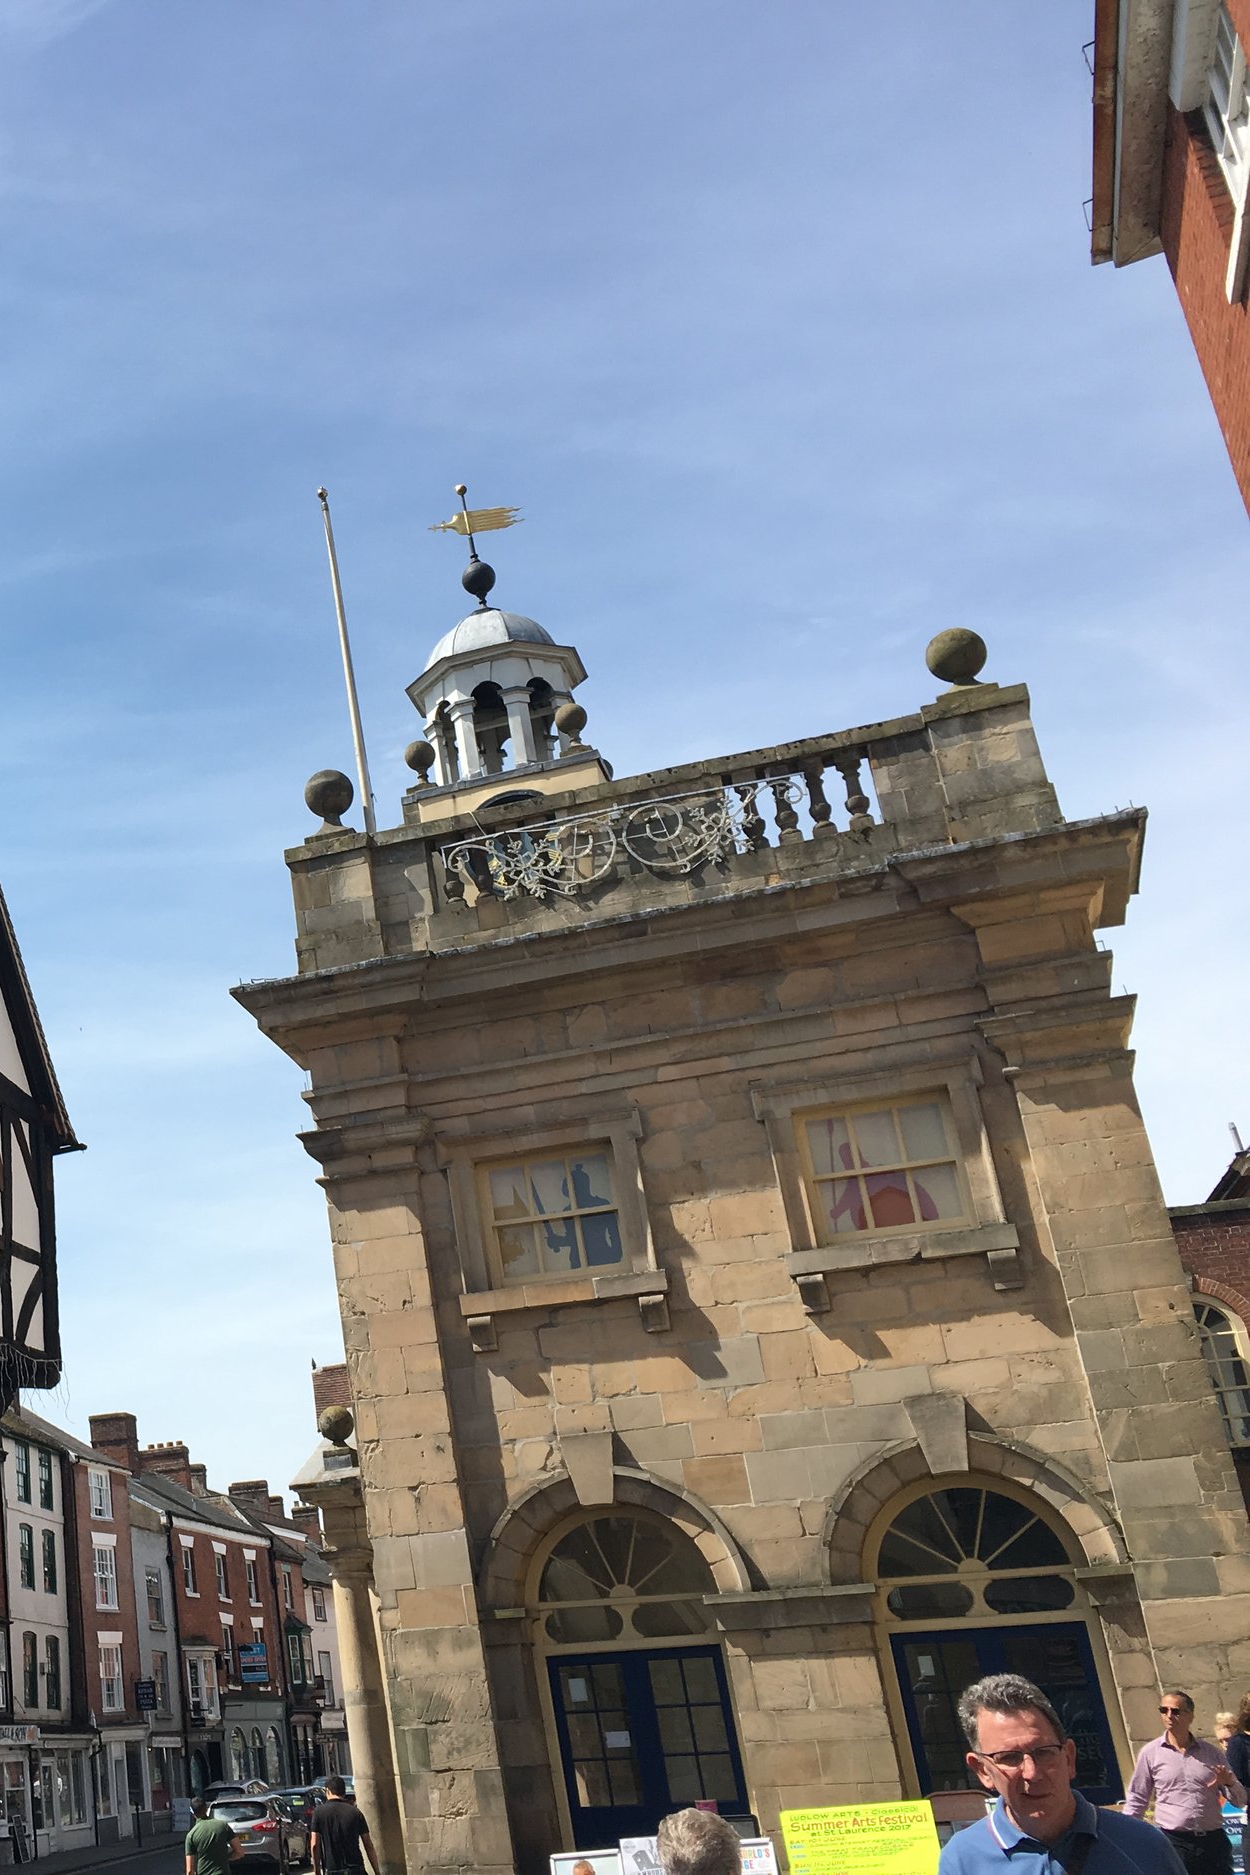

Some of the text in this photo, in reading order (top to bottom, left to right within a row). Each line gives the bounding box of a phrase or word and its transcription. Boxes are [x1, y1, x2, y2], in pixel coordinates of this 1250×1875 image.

[871, 1806, 919, 1815] Classical
[790, 1812, 928, 1833] Summer Arts Festival
[839, 1825, 886, 1835] Laurence
